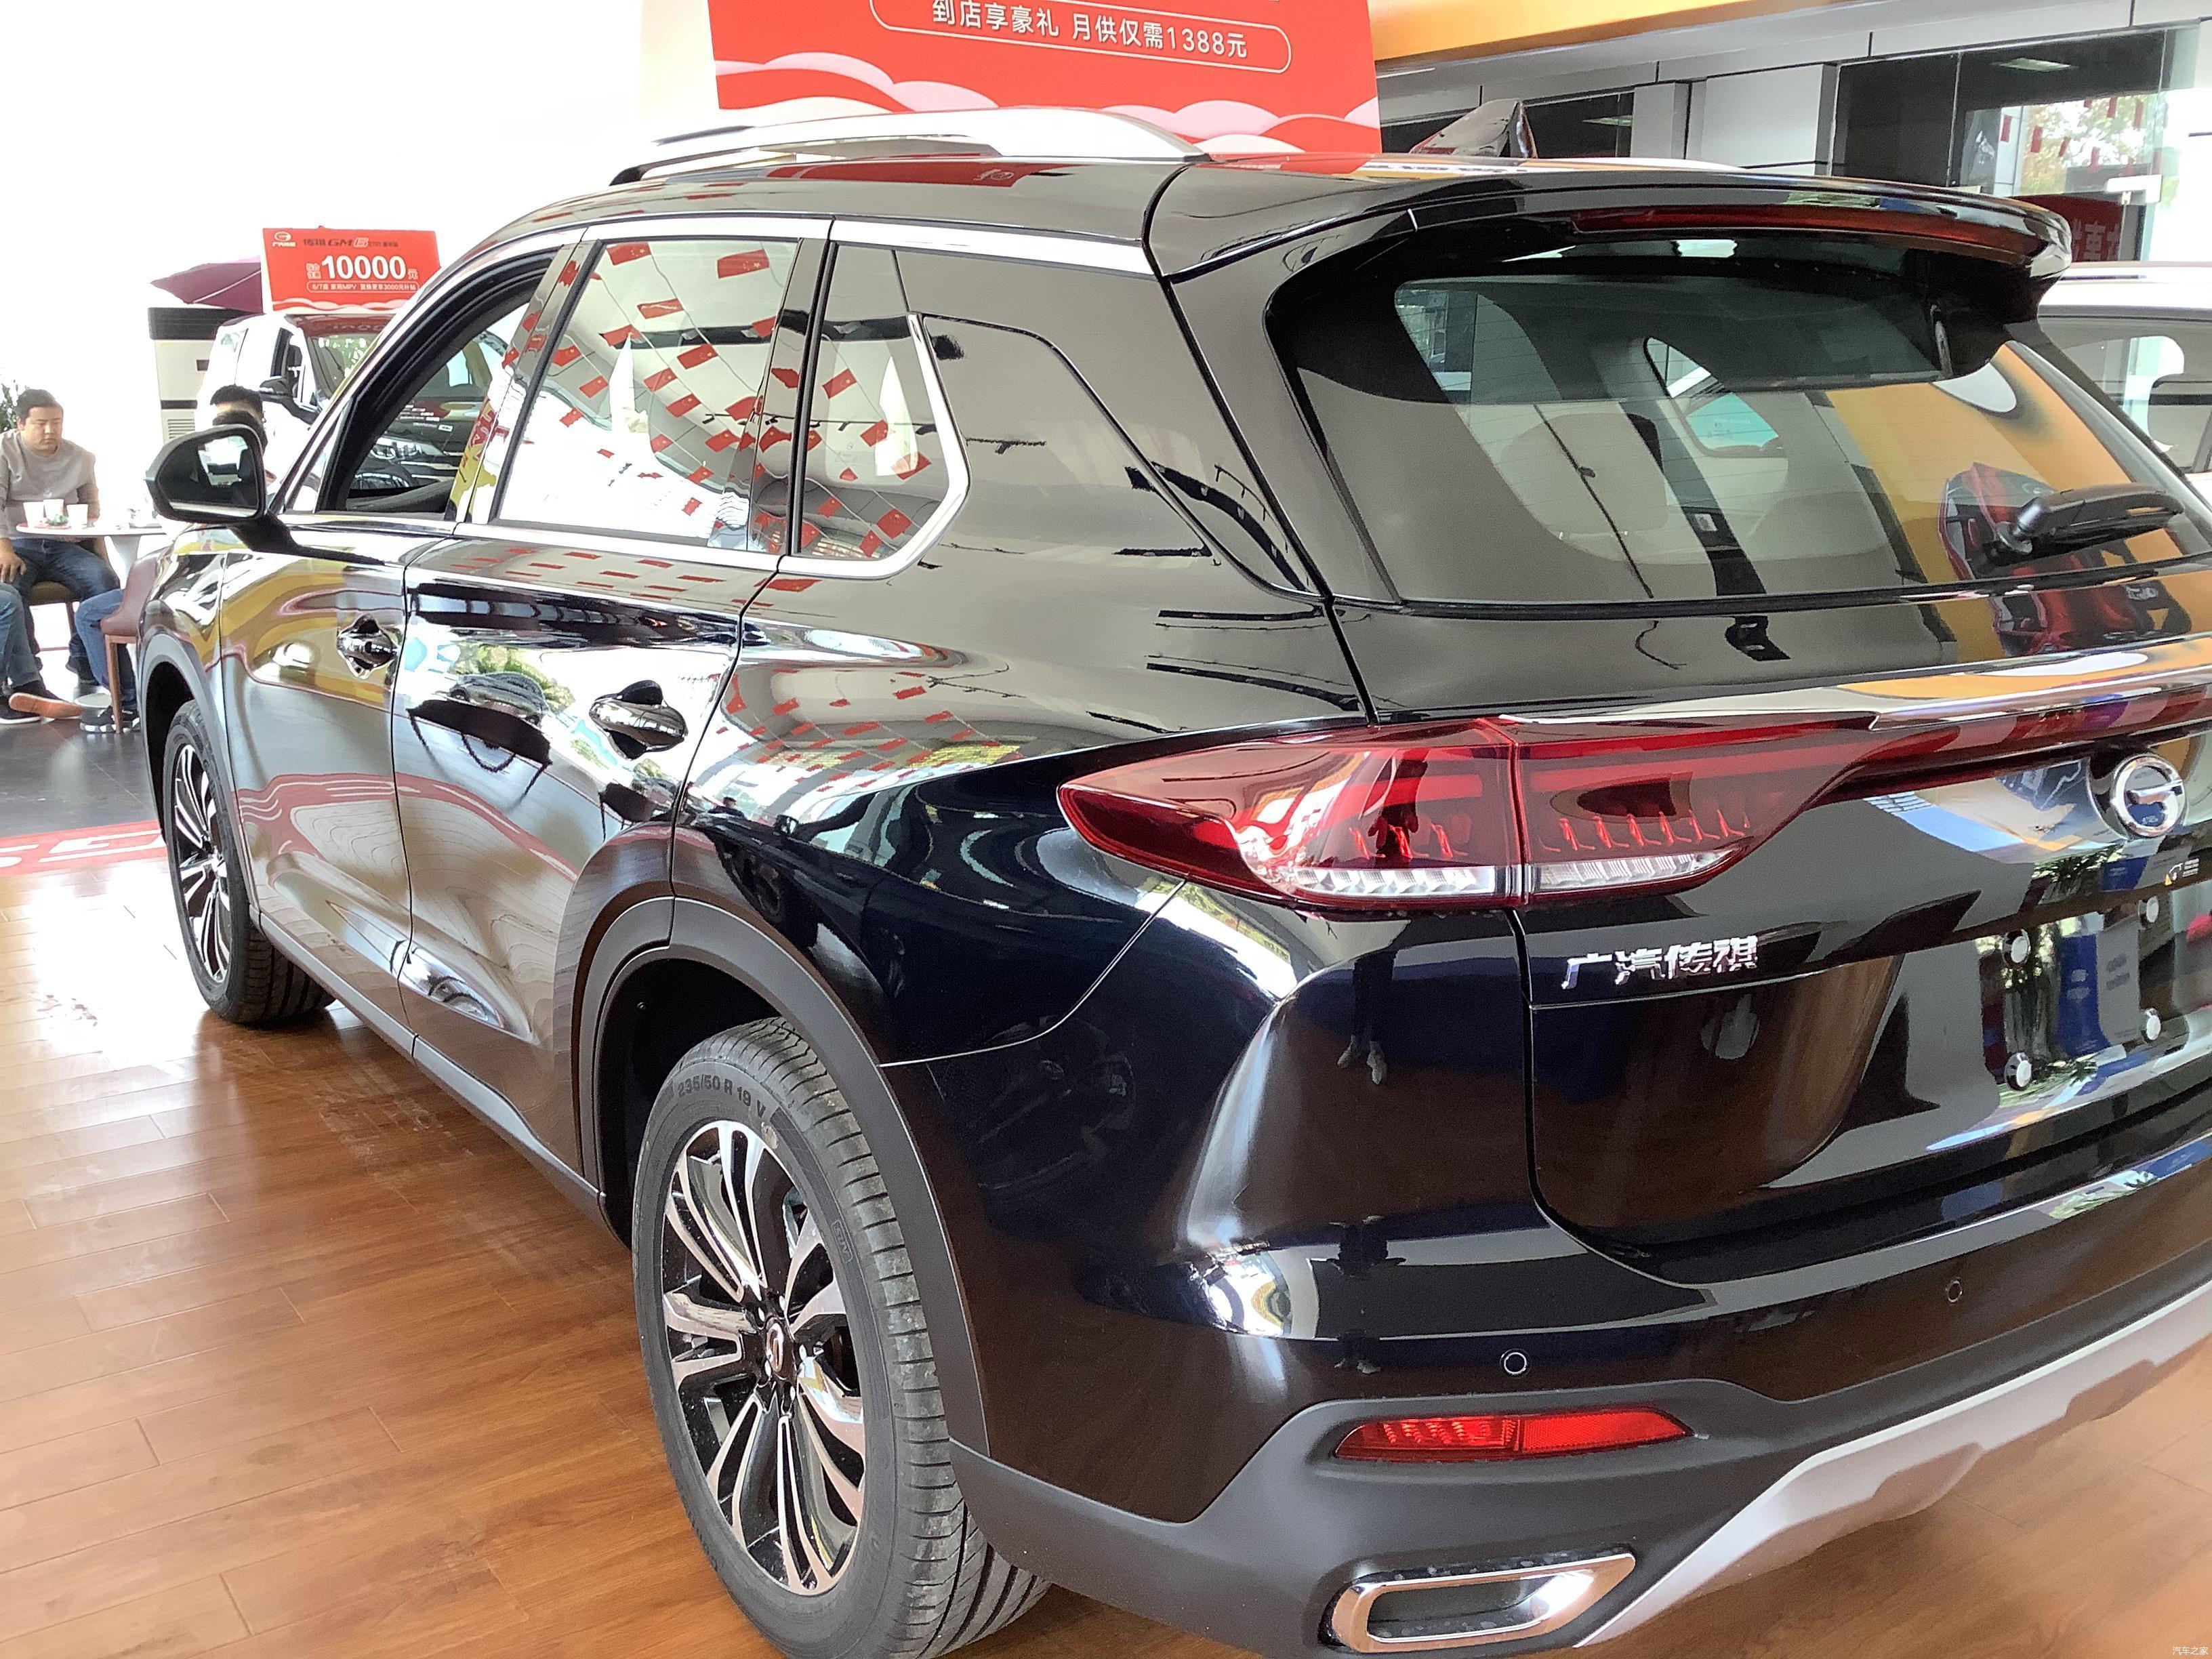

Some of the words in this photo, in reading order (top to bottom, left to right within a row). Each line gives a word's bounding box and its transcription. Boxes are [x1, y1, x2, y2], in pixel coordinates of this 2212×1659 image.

[932, 0, 1059, 36] 到店享豪礼
[1072, 13, 1247, 58] 月供仅需1388元
[1561, 935, 1759, 989] 广汽传祺
[678, 1073, 720, 1098] 235/50
[724, 1078, 733, 1095] R
[737, 1086, 752, 1107] 19
